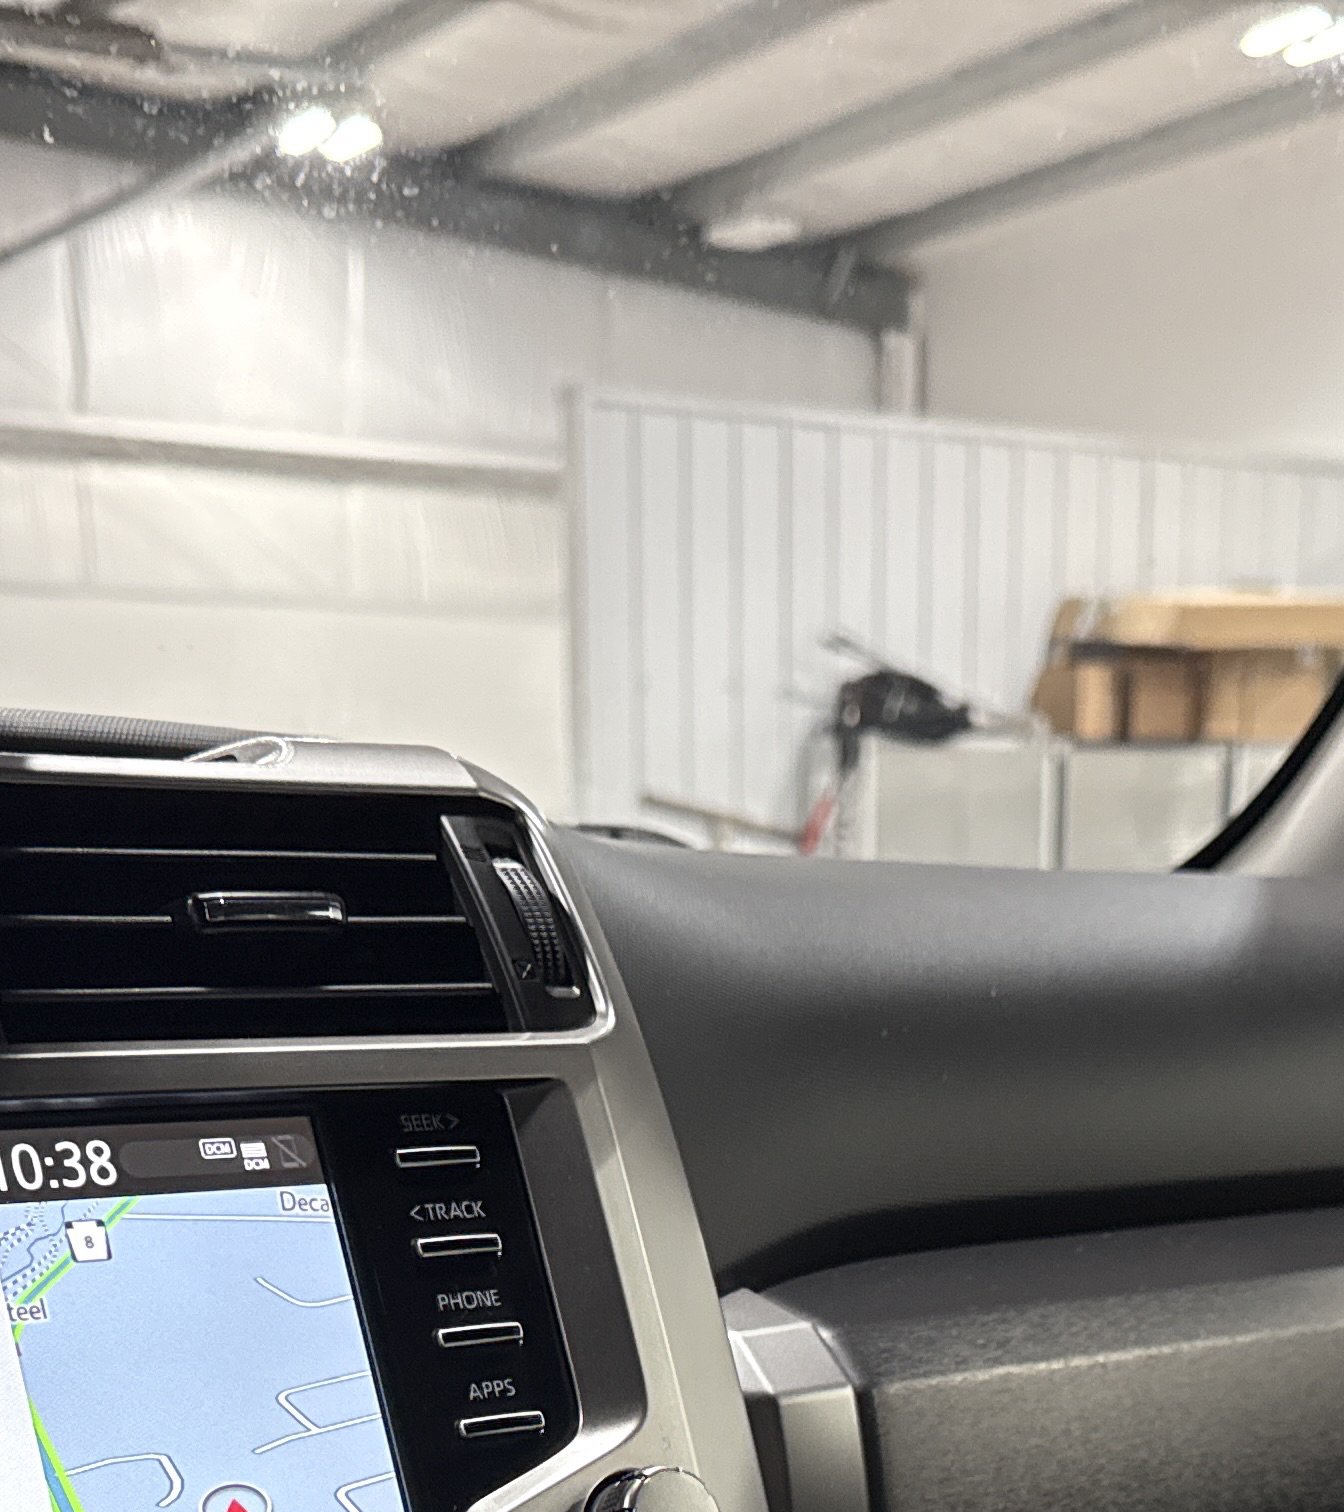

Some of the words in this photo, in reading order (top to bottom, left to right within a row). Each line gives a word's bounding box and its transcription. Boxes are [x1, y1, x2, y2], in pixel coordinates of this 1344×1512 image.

[280, 1191, 330, 1212] Deca
[84, 1235, 95, 1249] 8
[437, 1289, 502, 1312] PHONE
[469, 1378, 516, 1401] APPS
